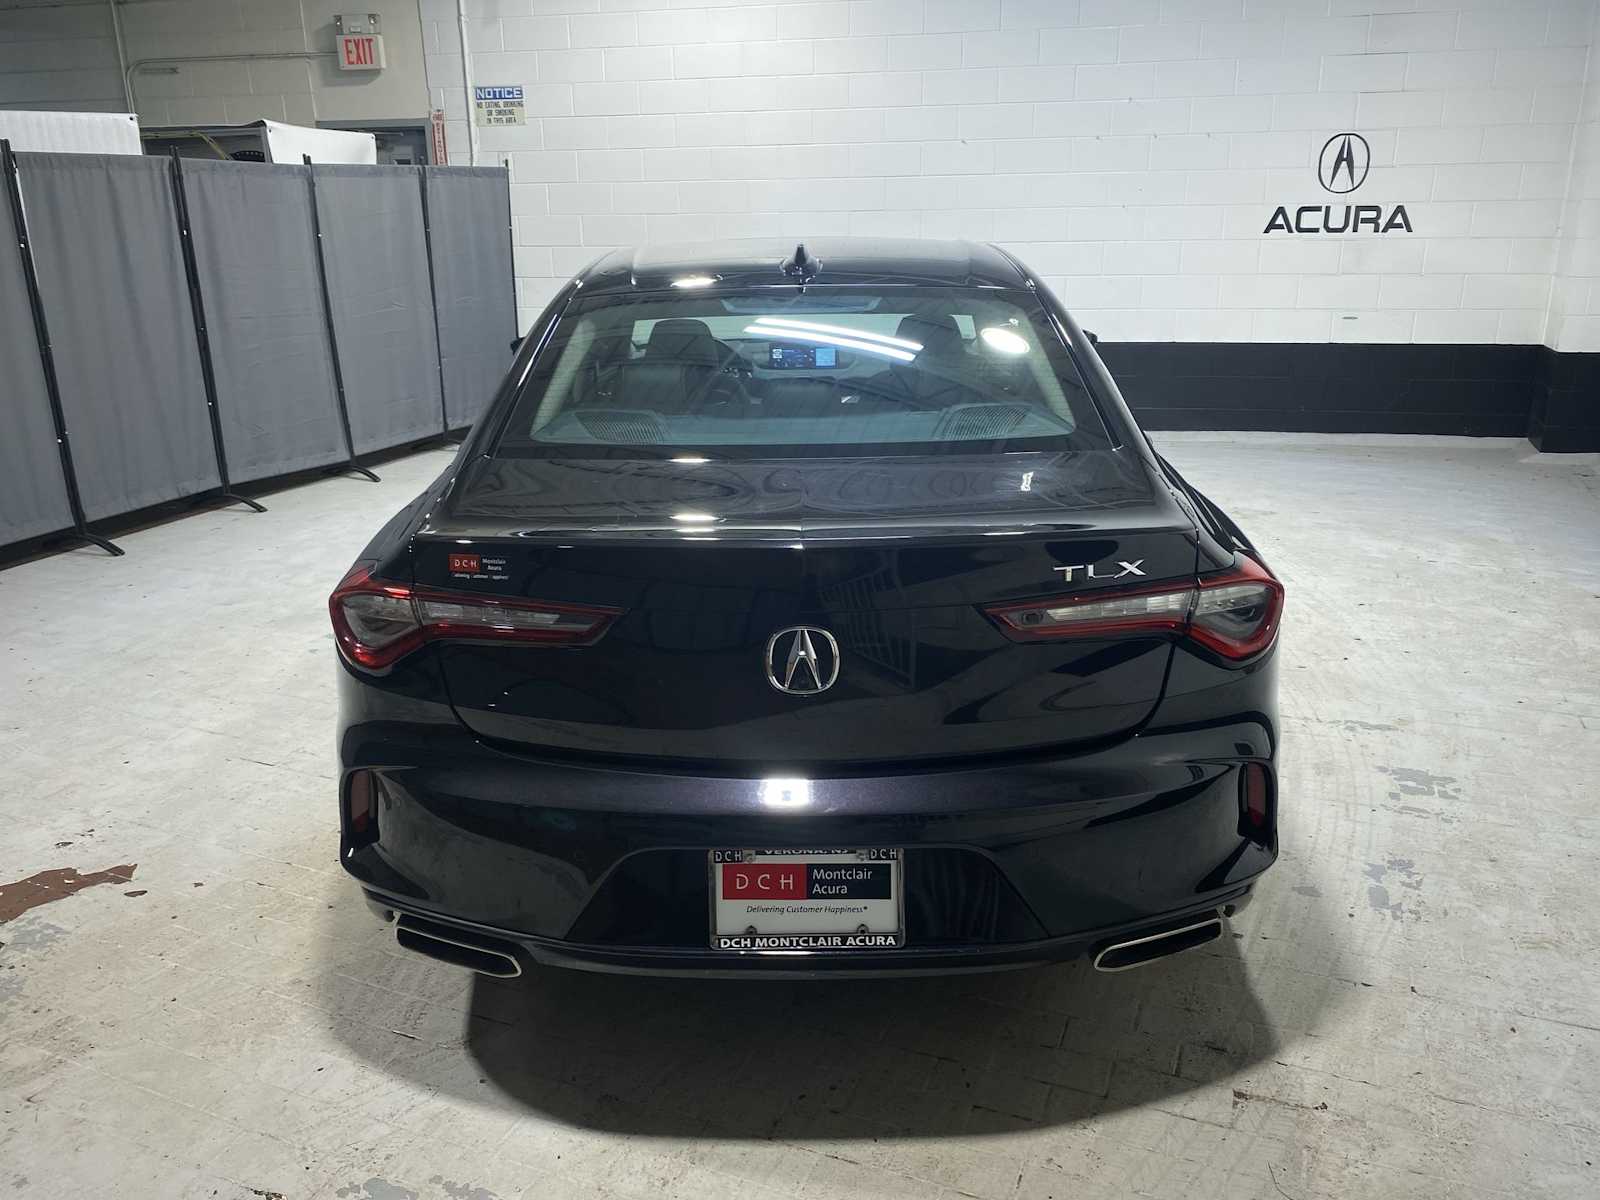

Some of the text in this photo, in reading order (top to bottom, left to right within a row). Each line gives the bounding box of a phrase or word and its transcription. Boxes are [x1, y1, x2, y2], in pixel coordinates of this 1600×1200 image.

[344, 38, 374, 65] EXIT
[476, 87, 522, 99] NOTICE
[495, 108, 515, 116] SMOKING
[1263, 205, 1413, 233] ACURA
[454, 559, 477, 568] DCH
[1053, 559, 1147, 582] TLX
[714, 850, 743, 862] DCH
[870, 848, 897, 859] DCH
[812, 868, 873, 880] Montclair
[735, 873, 794, 890] DCH
[812, 883, 848, 895] Acura
[746, 904, 785, 915] Delivering
[786, 904, 823, 913] Customer
[720, 935, 896, 948] DCH MONTCLAIR ACURA
